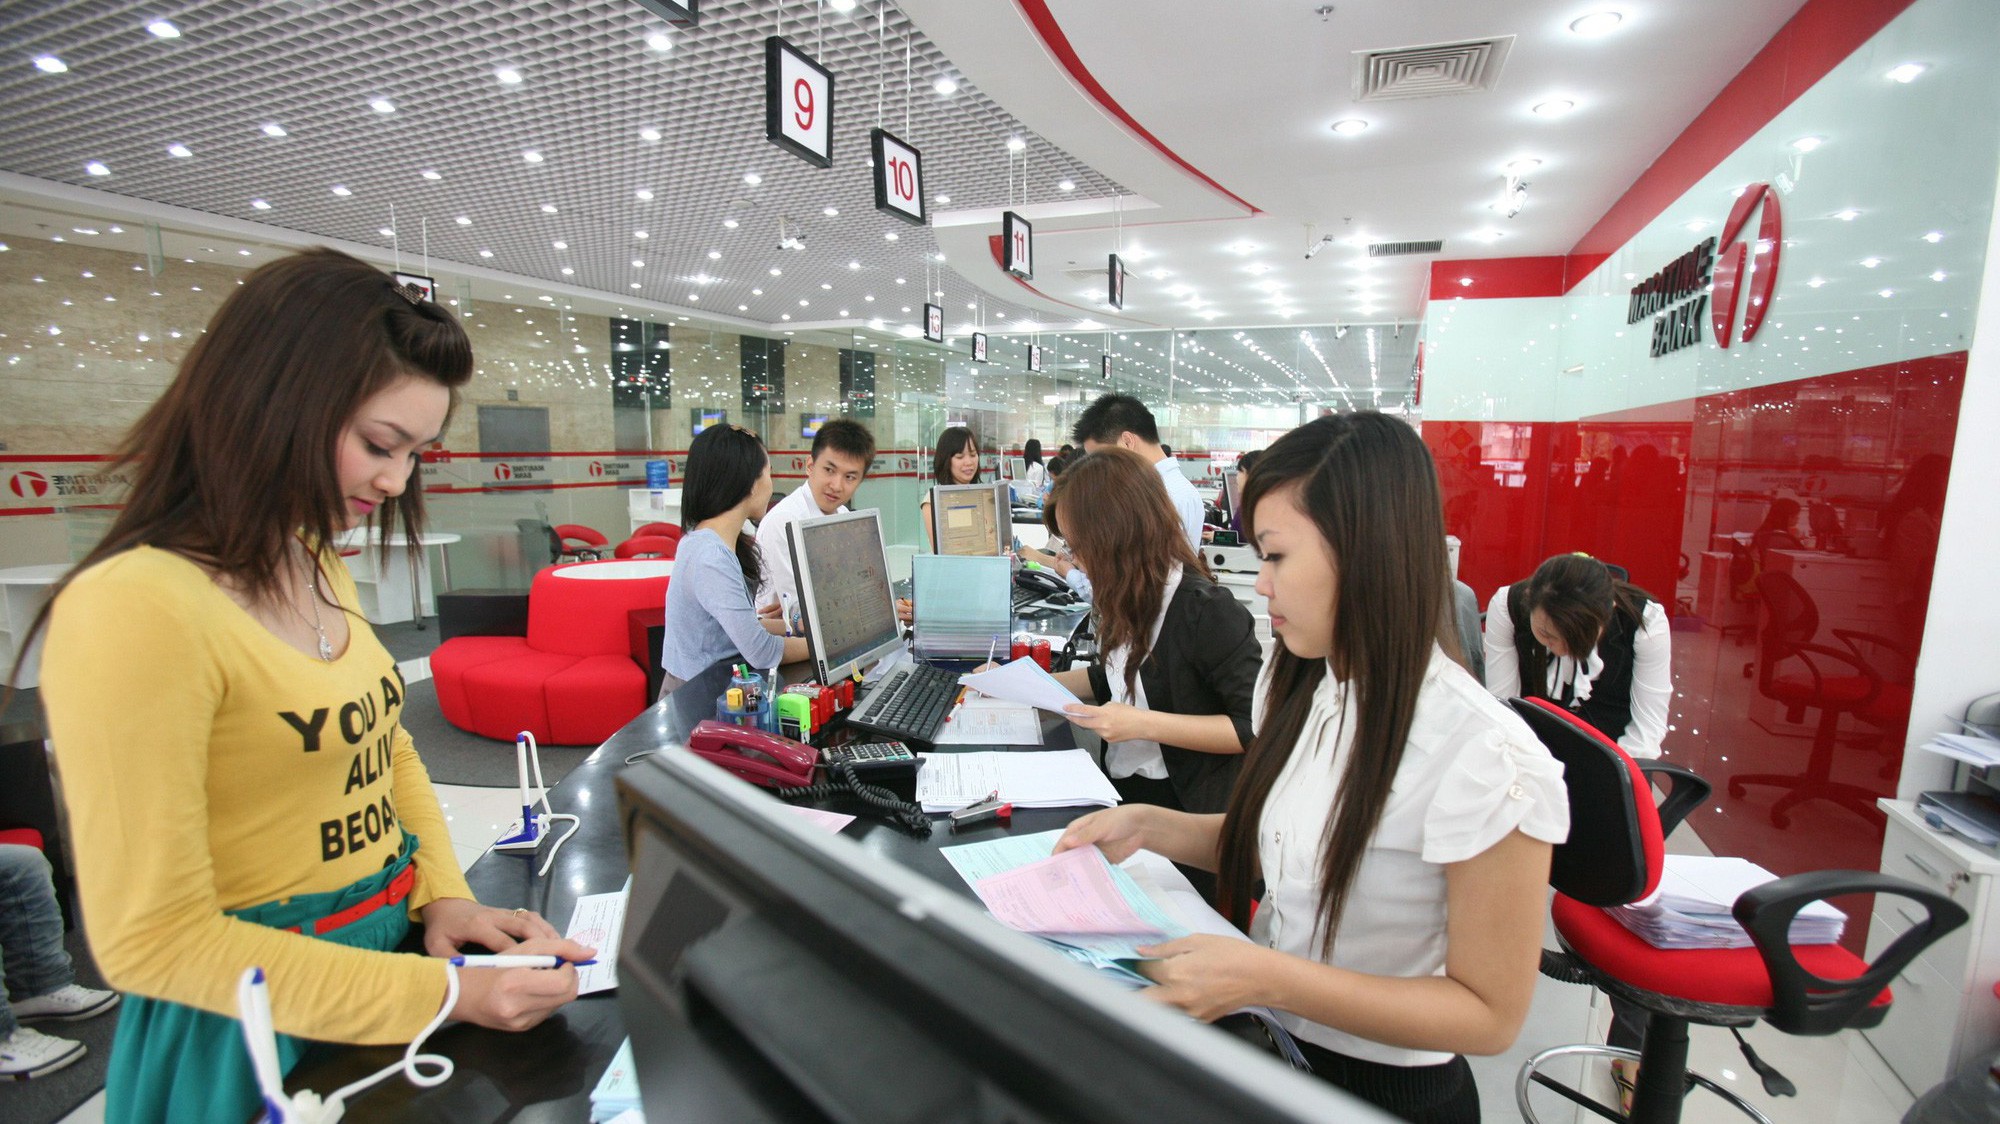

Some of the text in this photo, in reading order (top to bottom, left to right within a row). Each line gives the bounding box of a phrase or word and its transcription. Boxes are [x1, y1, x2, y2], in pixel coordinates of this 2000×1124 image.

[794, 78, 814, 131] 9
[889, 156, 914, 201] 10
[1014, 230, 1025, 263] 11
[1627, 236, 1716, 325] MARITIME
[1650, 295, 1708, 358] BANK
[277, 691, 377, 753] YOU
[344, 721, 397, 796] ALIV
